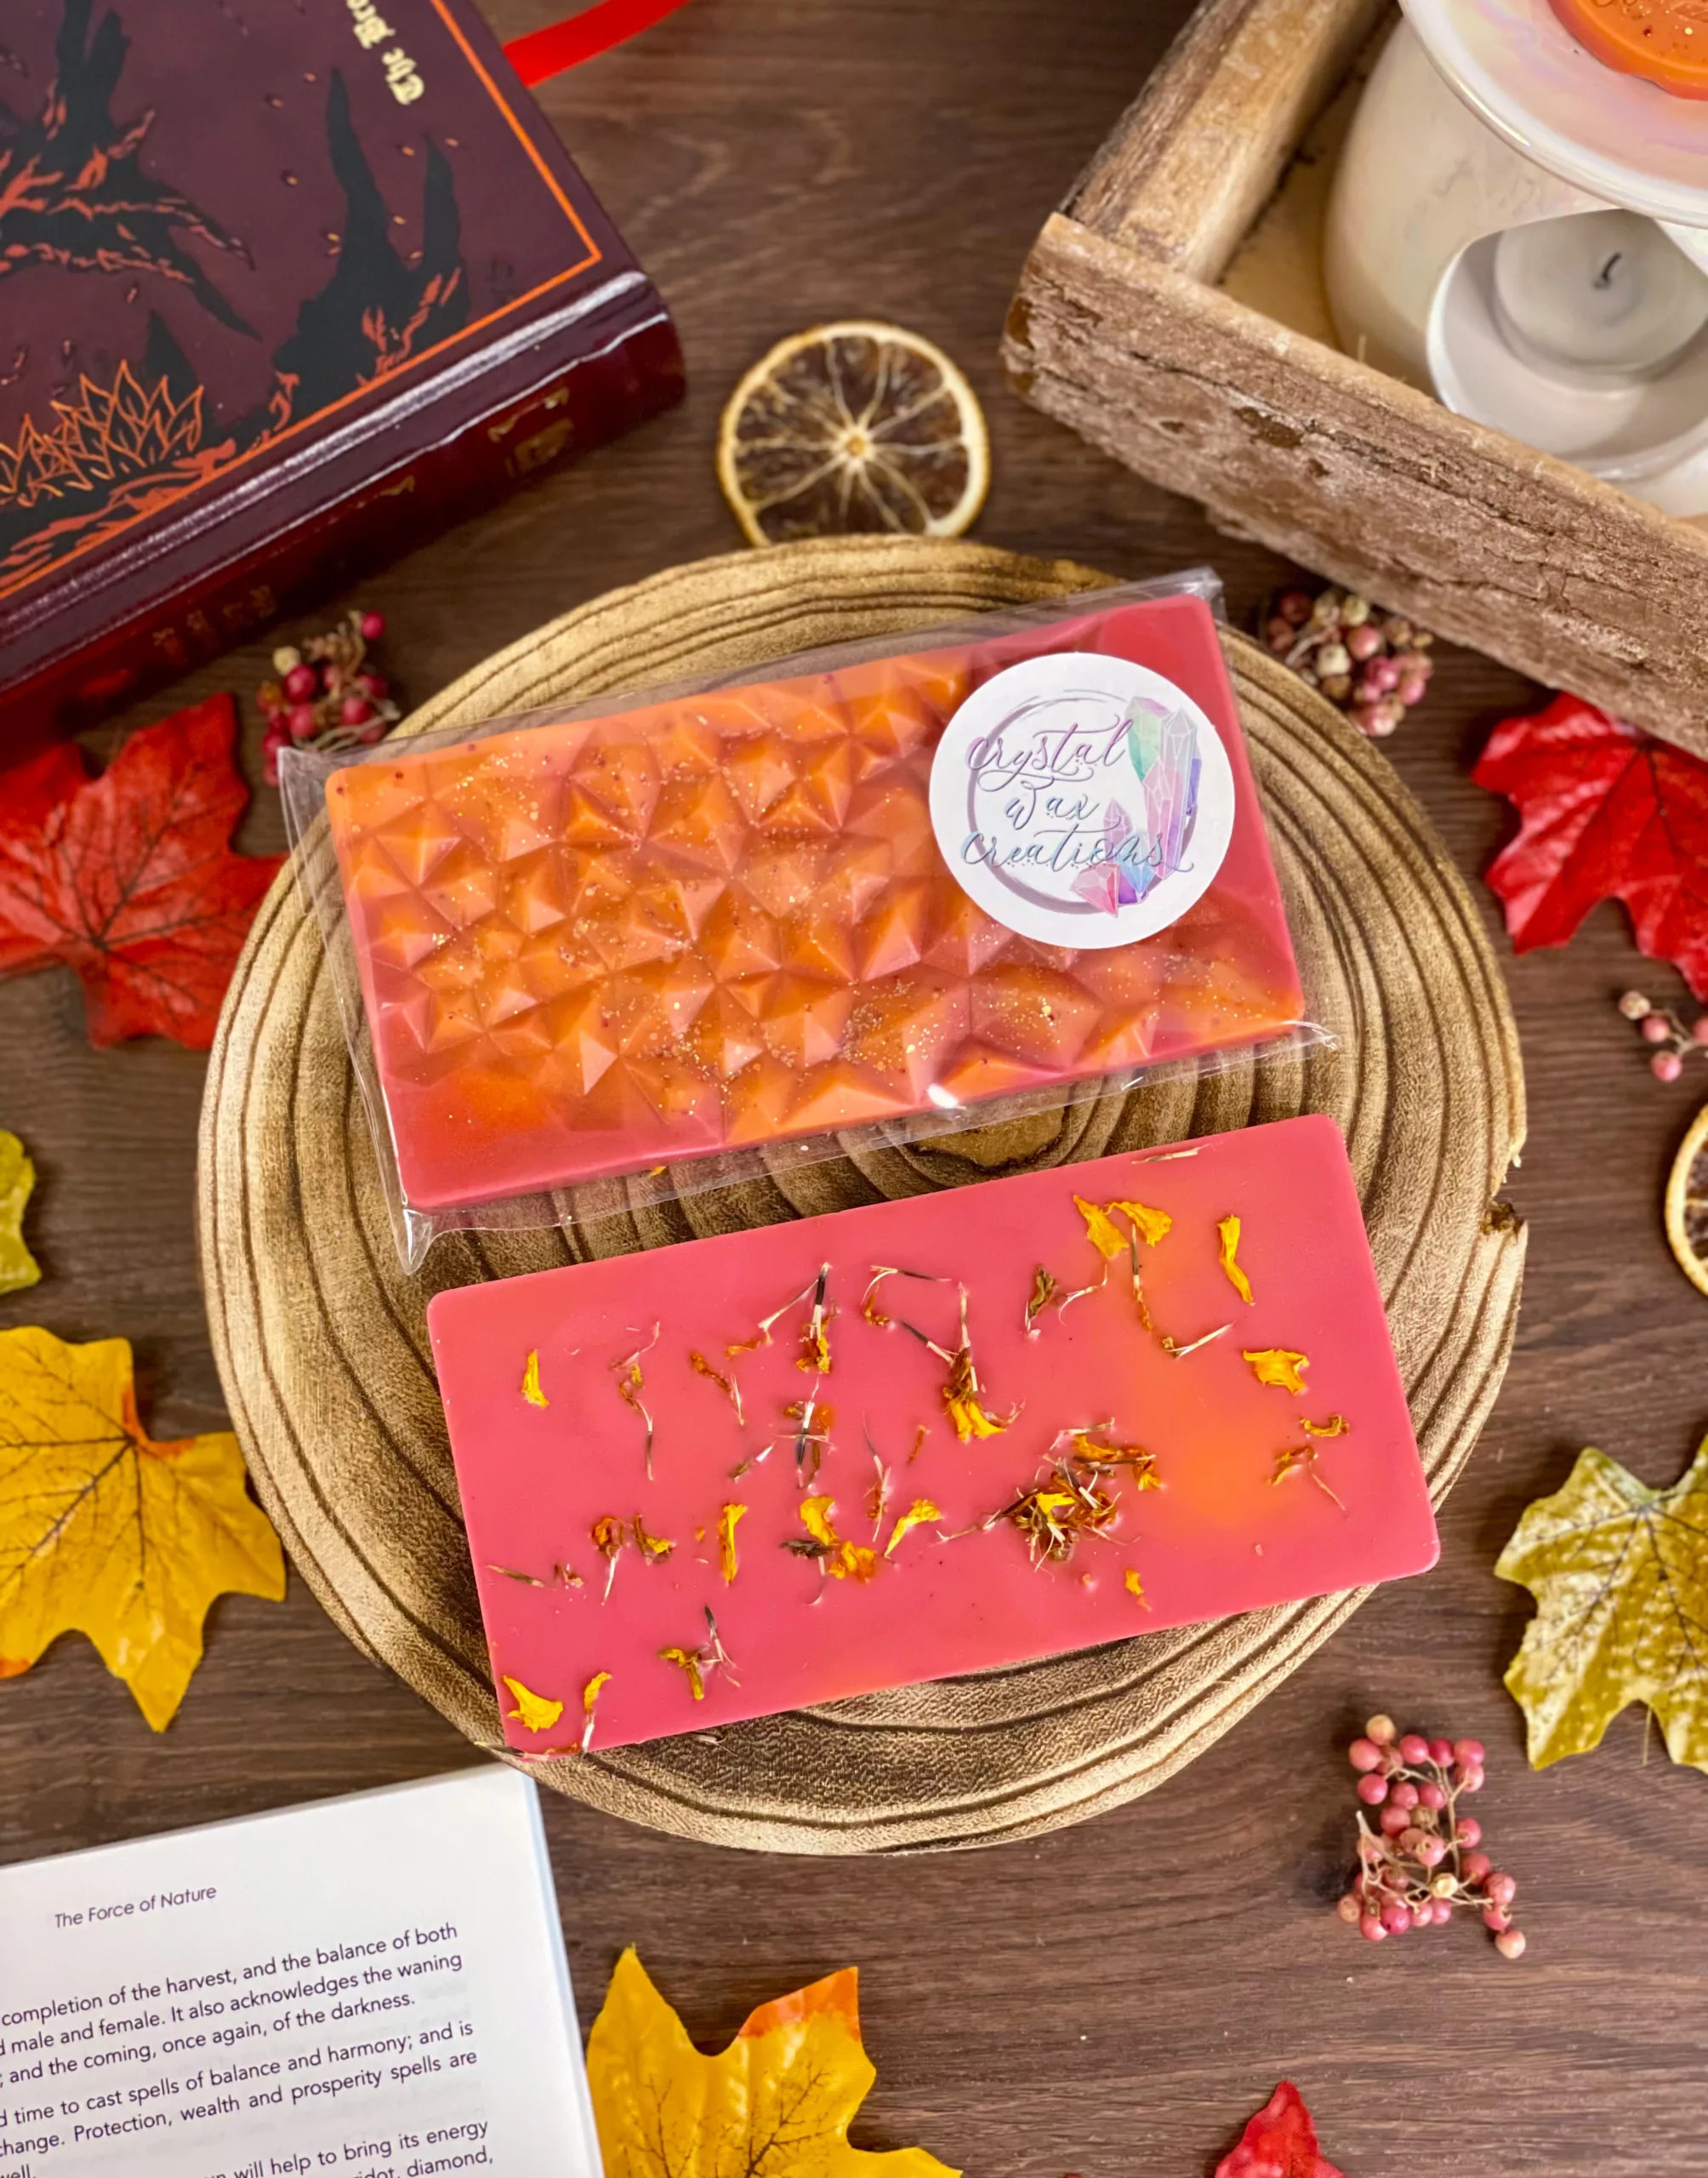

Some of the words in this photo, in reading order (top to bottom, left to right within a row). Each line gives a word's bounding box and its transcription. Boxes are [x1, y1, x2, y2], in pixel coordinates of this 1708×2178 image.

[54, 1913, 83, 1929] The
[88, 1902, 135, 1923] Force
[139, 1895, 157, 1913] of
[160, 1887, 217, 1908] Nature
[1, 1996, 103, 2027] completion
[108, 1985, 127, 2006] of
[130, 1982, 162, 2001] the
[165, 1969, 237, 1995] harvest,
[242, 1956, 277, 1980] and
[281, 1953, 311, 1972] the
[316, 1941, 387, 1965] balance
[392, 1929, 411, 1950] of
[414, 1921, 458, 1946] both
[10, 2030, 55, 2054] male
[60, 2021, 94, 2044] and
[98, 2010, 166, 2037] female.
[171, 2005, 185, 2022] It
[189, 1999, 225, 2020] also
[230, 1975, 360, 2011] acknowledges
[362, 1965, 393, 1985] the
[396, 1954, 463, 1978] waning
[9, 2060, 43, 2084] and
[48, 2056, 78, 2076] the
[83, 2044, 157, 2069] coming,
[162, 2034, 207, 2054] once
[212, 2021, 267, 2047] again,
[272, 2010, 291, 2032] of
[295, 2008, 326, 2027] the
[330, 1993, 415, 2021] darkness.
[13, 2106, 54, 2125] time
[60, 2101, 80, 2116] to
[86, 2090, 123, 2111] cast
[128, 2077, 180, 2107] spells
[185, 2070, 204, 2091] of
[209, 2061, 281, 2086] balance
[288, 2047, 322, 2072] and
[327, 2035, 413, 2063] harmony;
[418, 2021, 453, 2045] and
[458, 2020, 474, 2037] is
[73, 2113, 173, 2142] Protection,
[179, 2094, 241, 2121] wealth
[248, 2084, 283, 2108] and
[291, 2069, 382, 2106] prosperity
[390, 2055, 442, 2084] spells
[449, 2051, 477, 2068] are
[233, 2160, 265, 2178] will
[270, 2153, 311, 2176] help
[316, 2151, 338, 2166] to
[343, 2141, 392, 2161] bring
[398, 2133, 420, 2150] its
[425, 2121, 488, 2145] energy
[407, 2144, 493, 2178] diamond,
